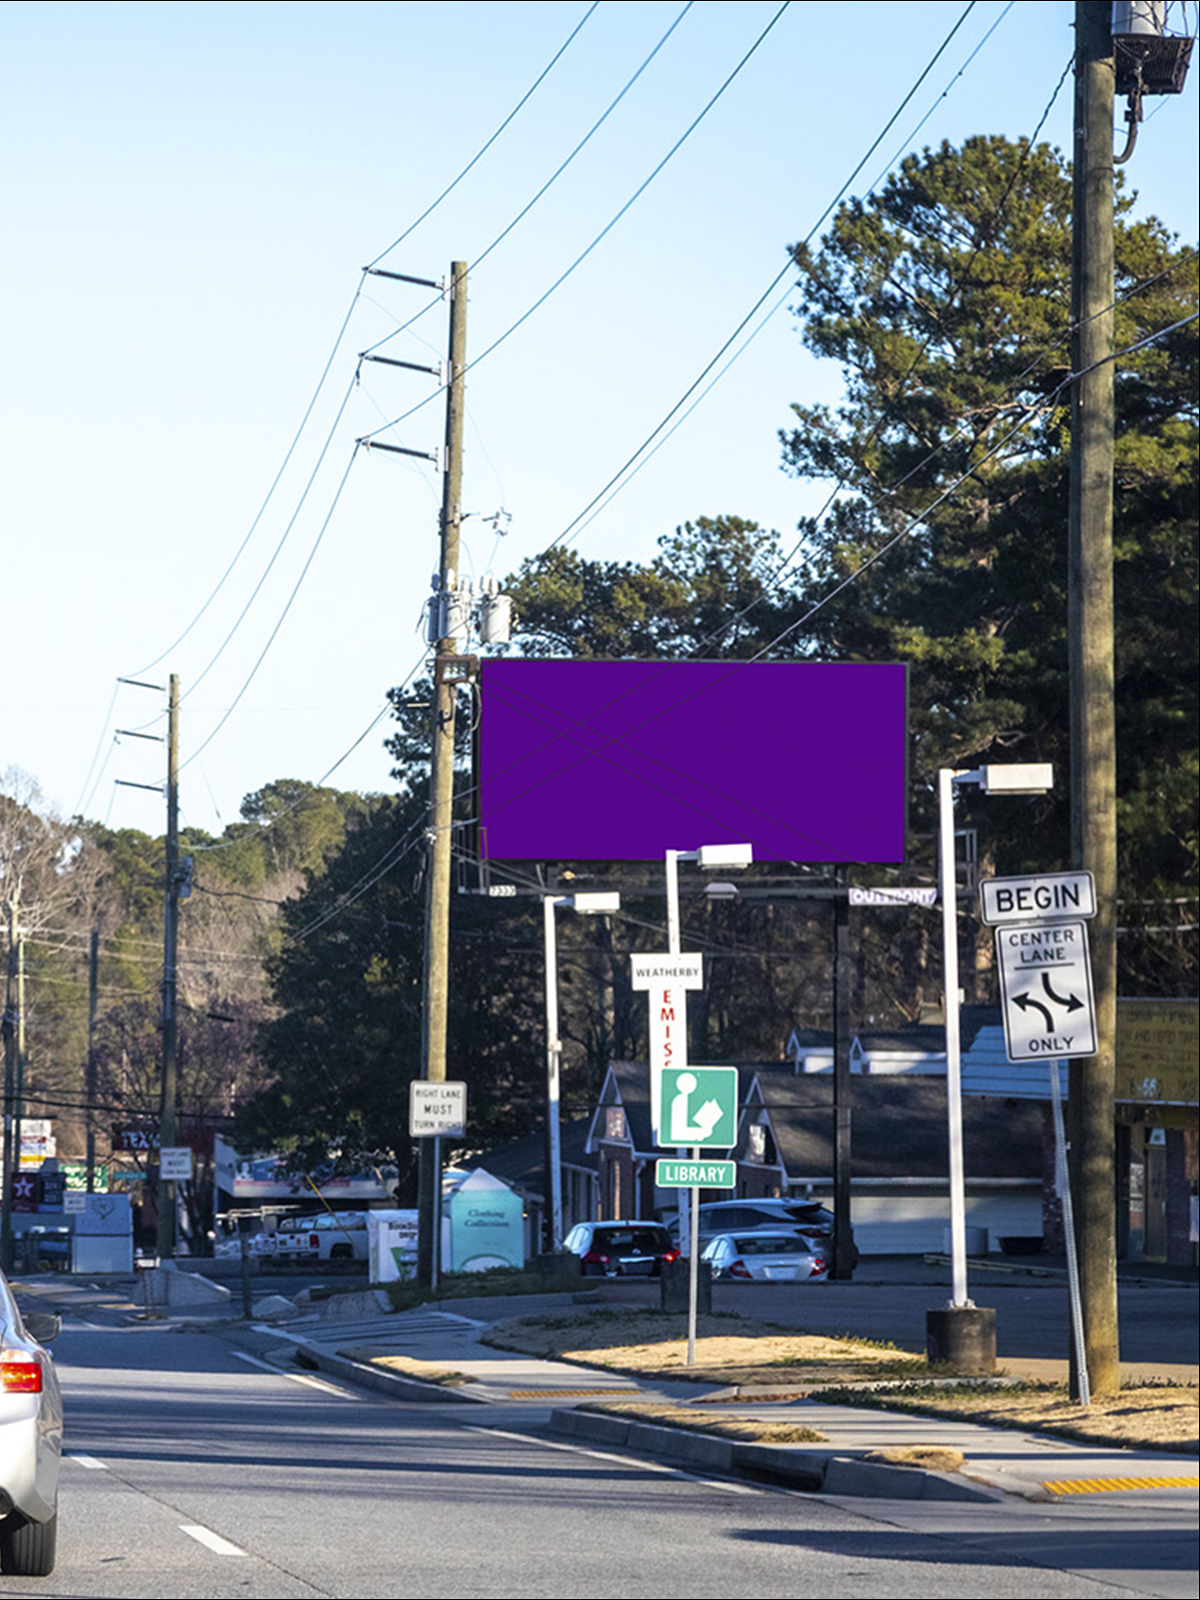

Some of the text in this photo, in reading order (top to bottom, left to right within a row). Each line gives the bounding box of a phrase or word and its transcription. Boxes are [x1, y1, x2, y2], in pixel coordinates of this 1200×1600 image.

[996, 883, 1080, 913] BEGIN
[1008, 929, 1075, 947] CENTER
[1020, 947, 1066, 963] LANE
[636, 967, 700, 978] WEATHERBY
[1028, 1036, 1075, 1052] ONLY
[416, 1090, 461, 1099] RIGHT LANE
[424, 1104, 452, 1115] MUST
[415, 1120, 435, 1129] TURN
[666, 1166, 726, 1182] LIBRARY
